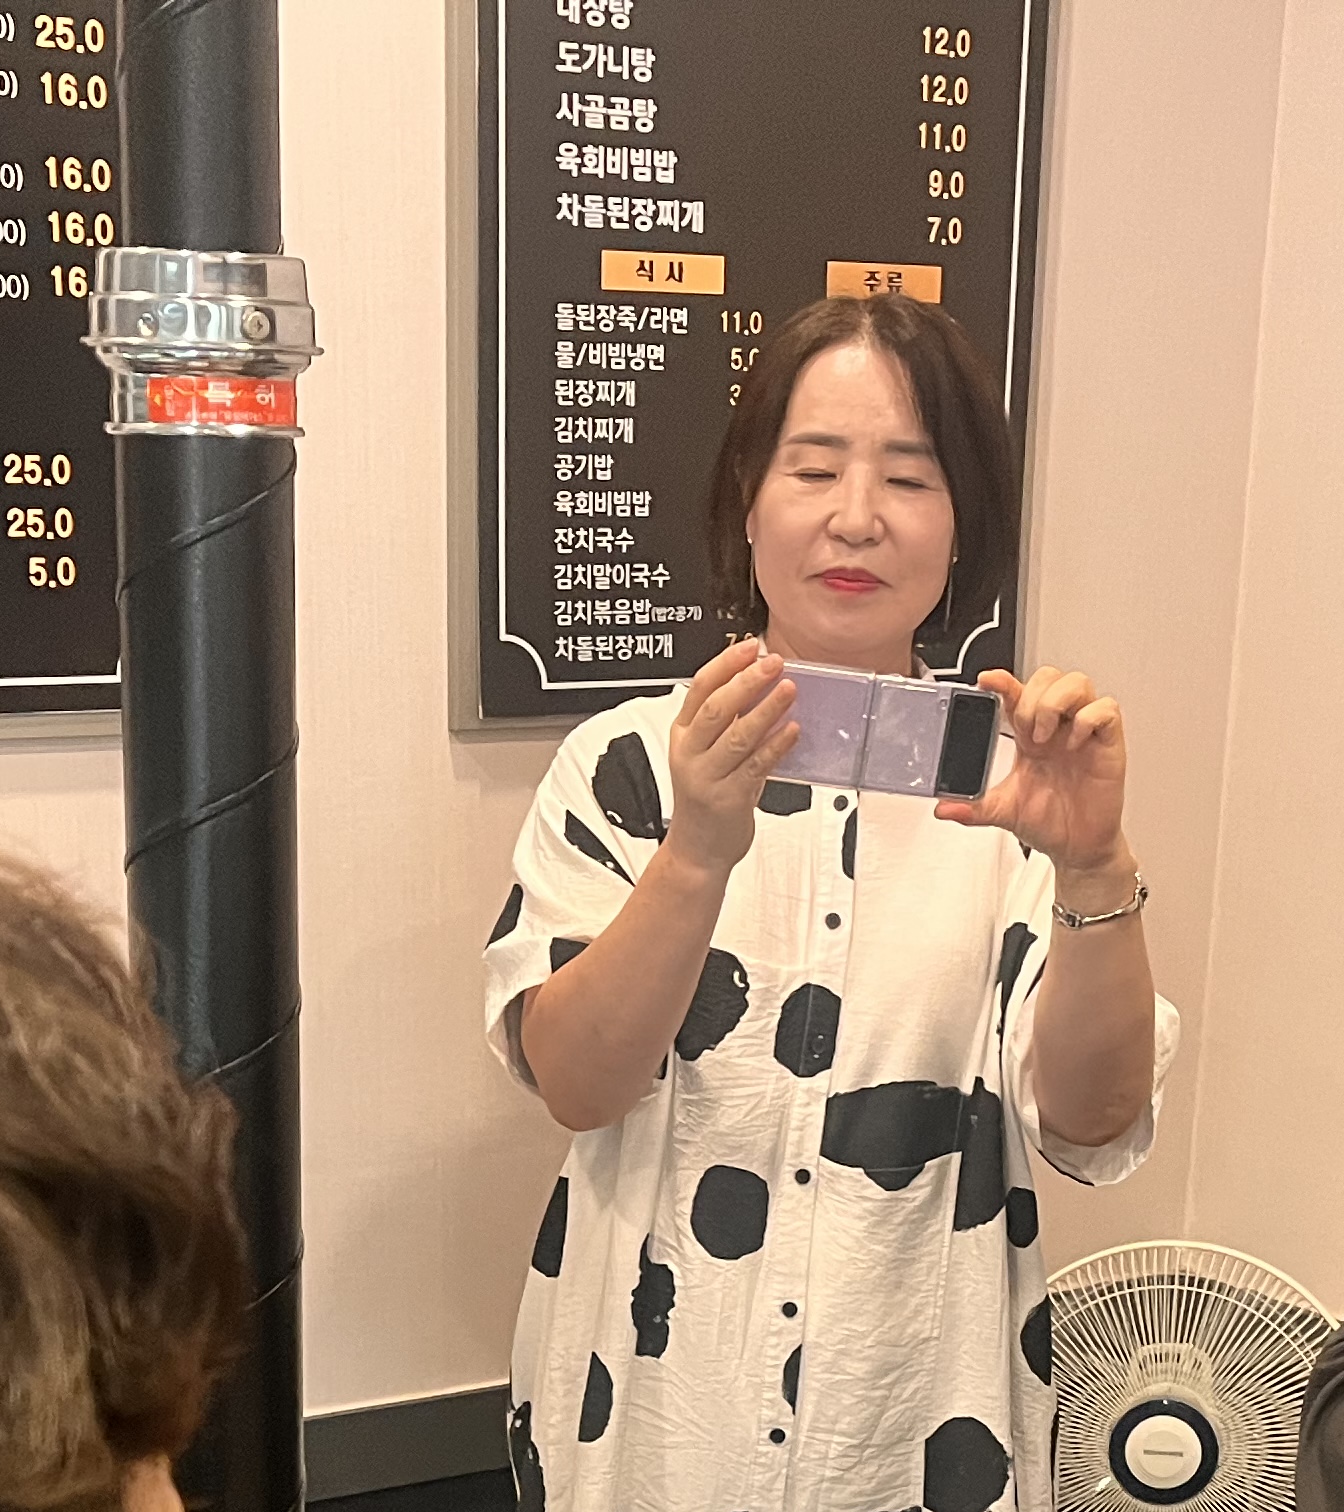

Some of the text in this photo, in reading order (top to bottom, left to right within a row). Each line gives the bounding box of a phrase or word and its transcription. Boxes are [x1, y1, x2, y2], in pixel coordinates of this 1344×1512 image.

[34, 14, 104, 54] 25.0
[922, 26, 971, 58] 12.0
[555, 41, 968, 106] 도가니탕 12.0
[40, 71, 107, 110] 16.0
[555, 92, 966, 153] 사골곰탕 11.0
[44, 156, 111, 193] 16.0
[555, 142, 964, 200] 육회비빔밥 9.0
[47, 210, 114, 247] 16.0
[555, 192, 962, 246] 차돌된장찌개 7.0
[49, 264, 94, 298] 16.
[554, 302, 762, 336] 돌된장죽/라면 11.0
[554, 341, 665, 371] 물/비빔냉면
[554, 378, 636, 407] 된장찌개
[554, 416, 634, 444] 김치찌개
[3, 453, 71, 487] 25.0
[553, 453, 615, 481] 공기밥
[553, 490, 652, 518] 육회비빔밥
[6, 507, 73, 540] 25.0
[553, 527, 635, 554] 잔치국수
[29, 556, 76, 589] 5.0
[553, 563, 671, 590] 김치말이국수
[554, 633, 673, 662] 차돌된장찌개
